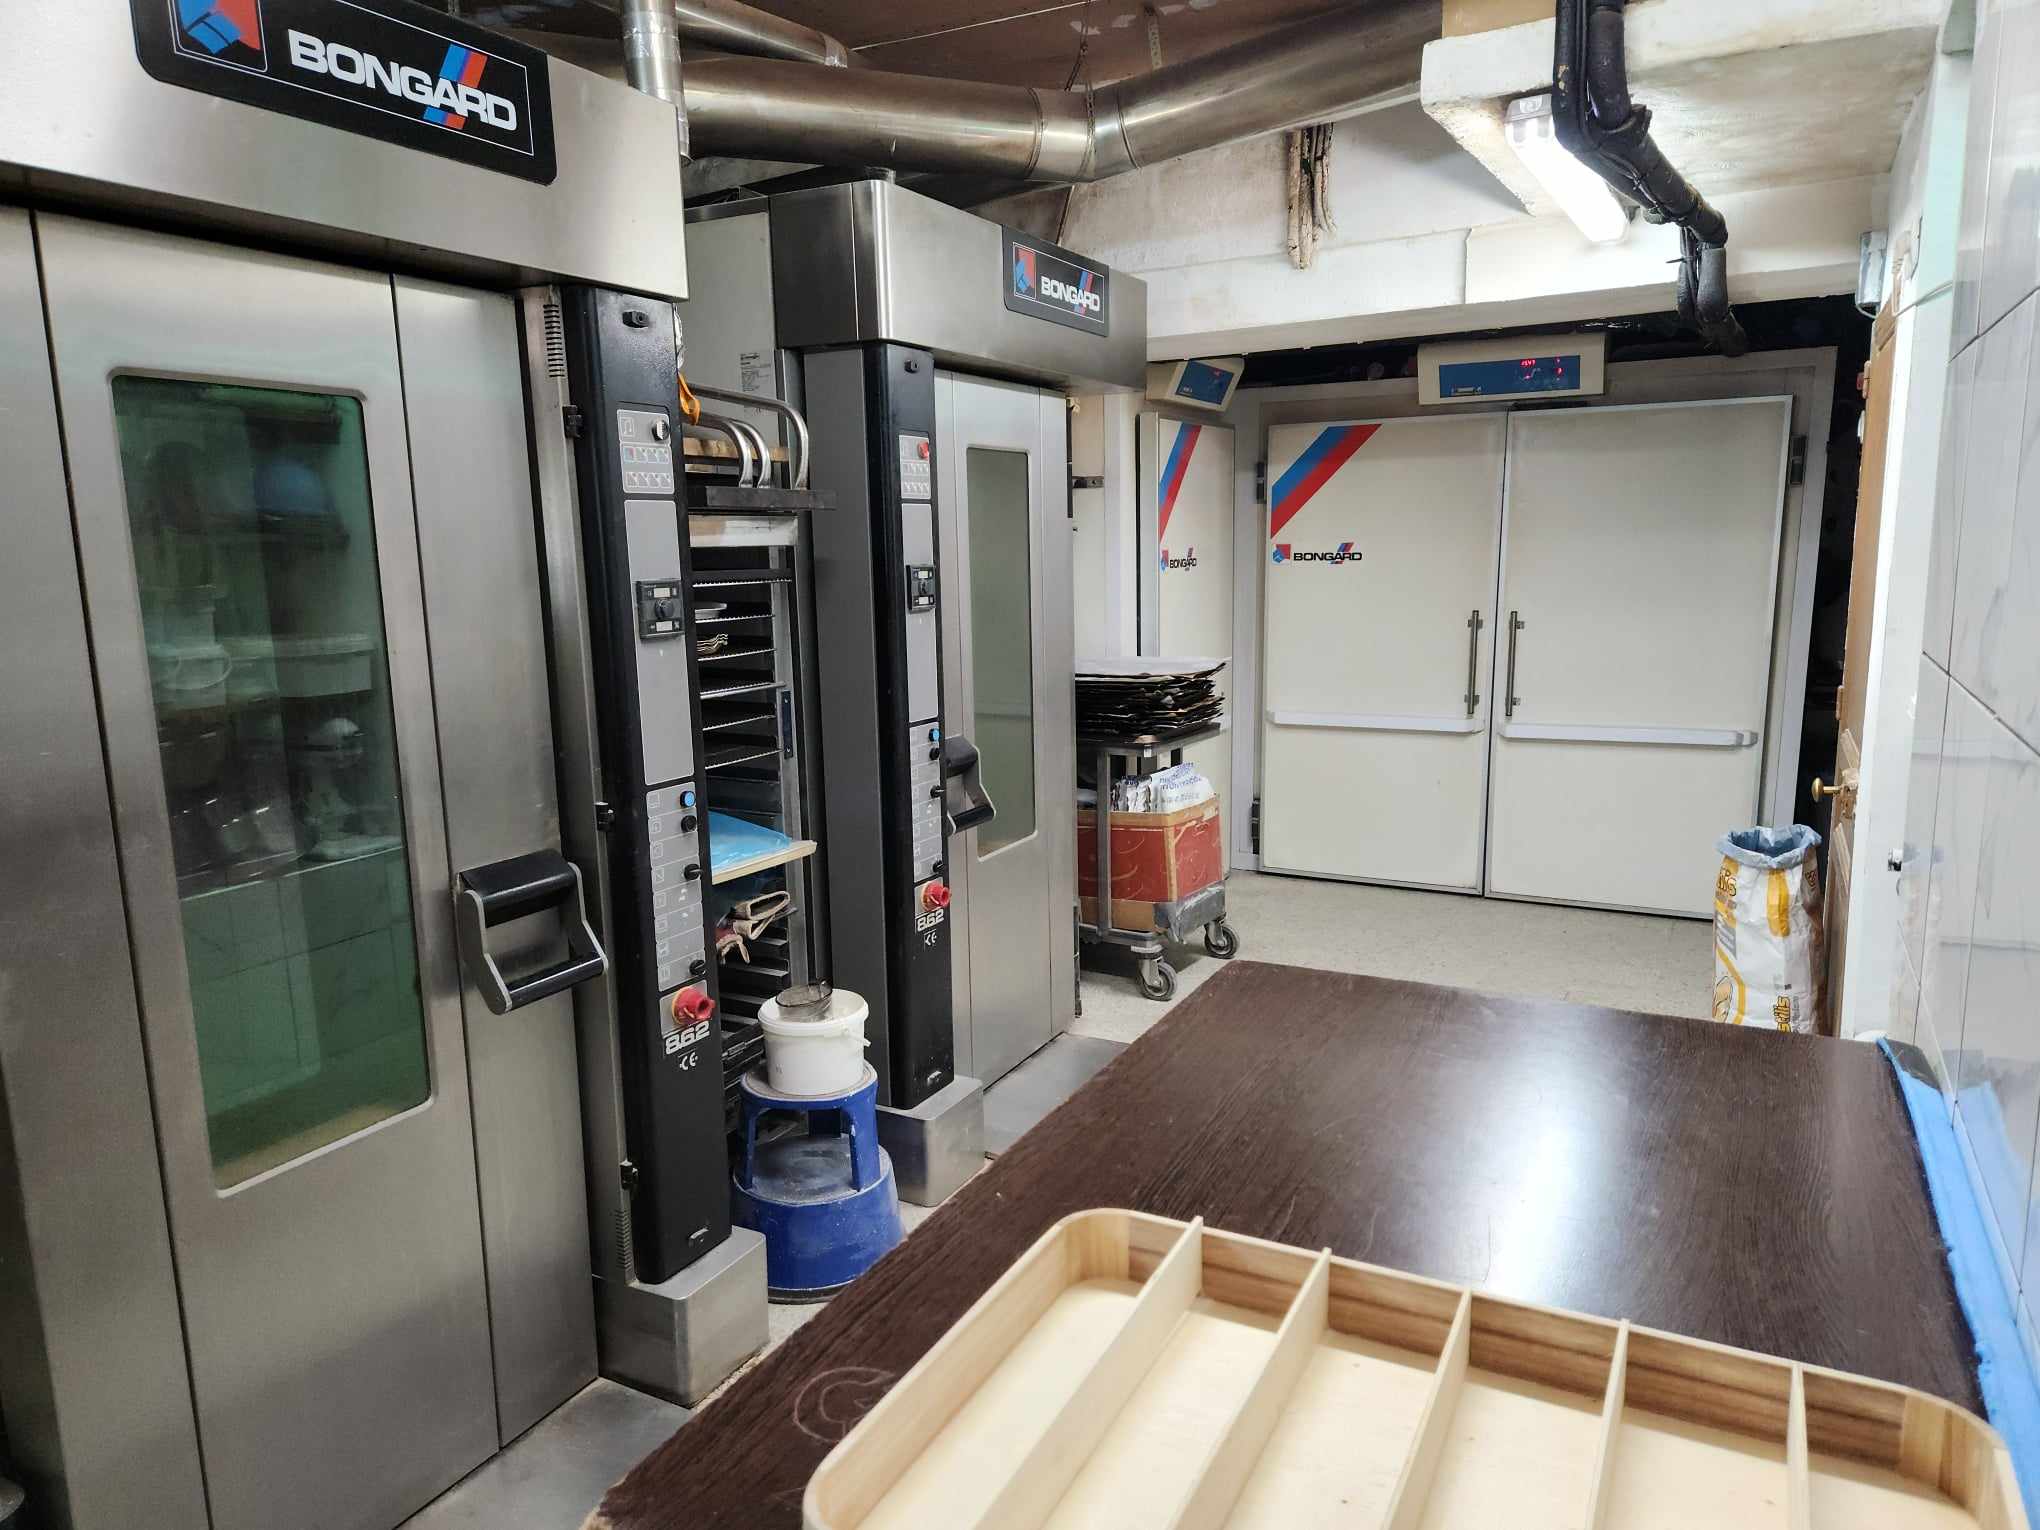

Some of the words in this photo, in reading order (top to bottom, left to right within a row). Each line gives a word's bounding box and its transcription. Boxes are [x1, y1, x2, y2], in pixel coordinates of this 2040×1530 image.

[288, 29, 517, 131] BONGARD
[1040, 275, 1101, 312] BONGARD
[1293, 552, 1362, 561] BONGARD
